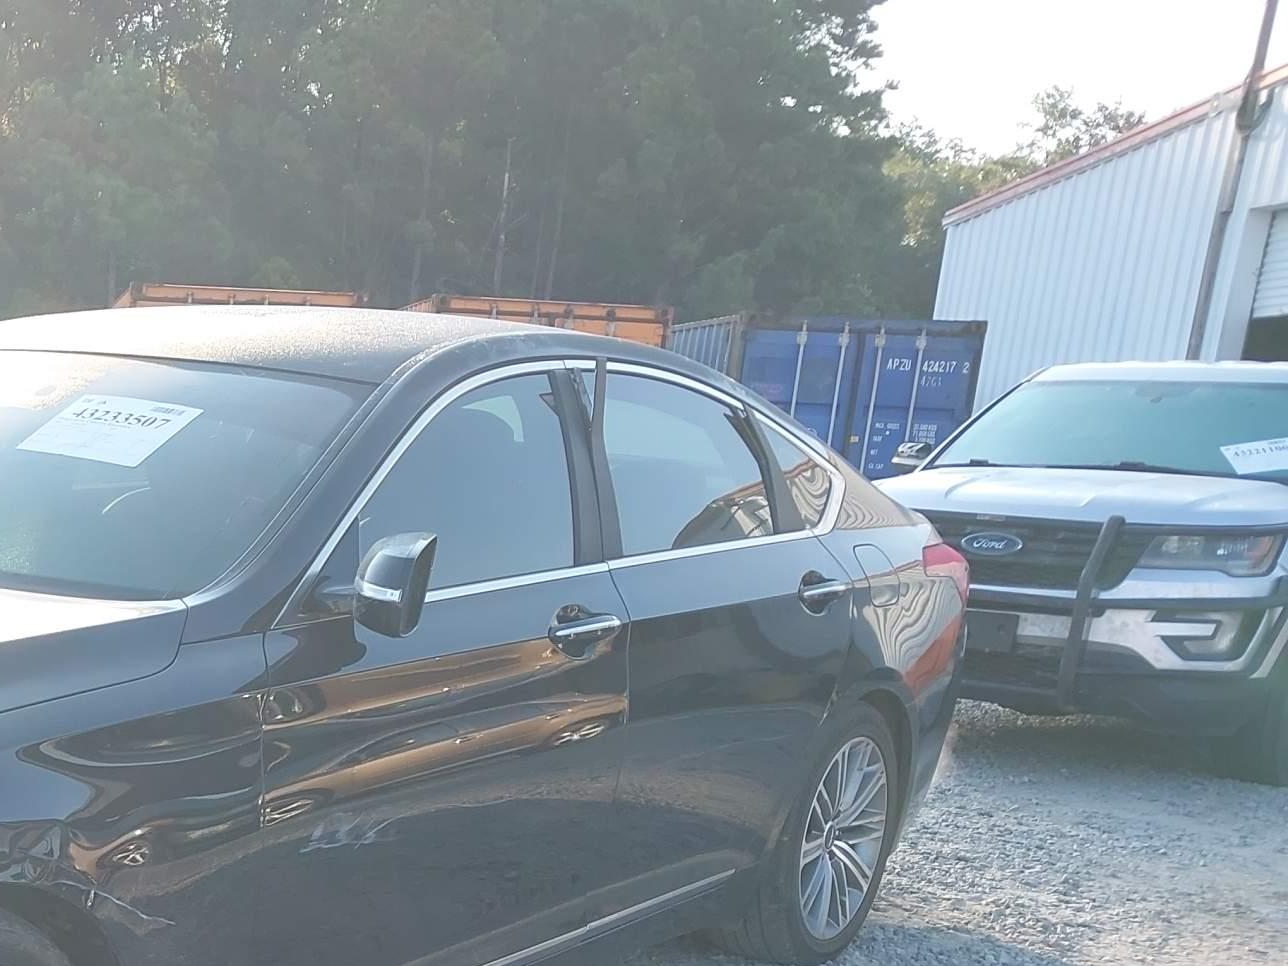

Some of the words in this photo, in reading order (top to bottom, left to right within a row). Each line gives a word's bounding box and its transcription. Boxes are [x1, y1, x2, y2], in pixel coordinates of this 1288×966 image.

[887, 359, 912, 371] APZU
[922, 360, 957, 374] 424217
[962, 362, 970, 374] 2
[72, 407, 172, 430] 43233507
[972, 538, 1008, 550] Ford
